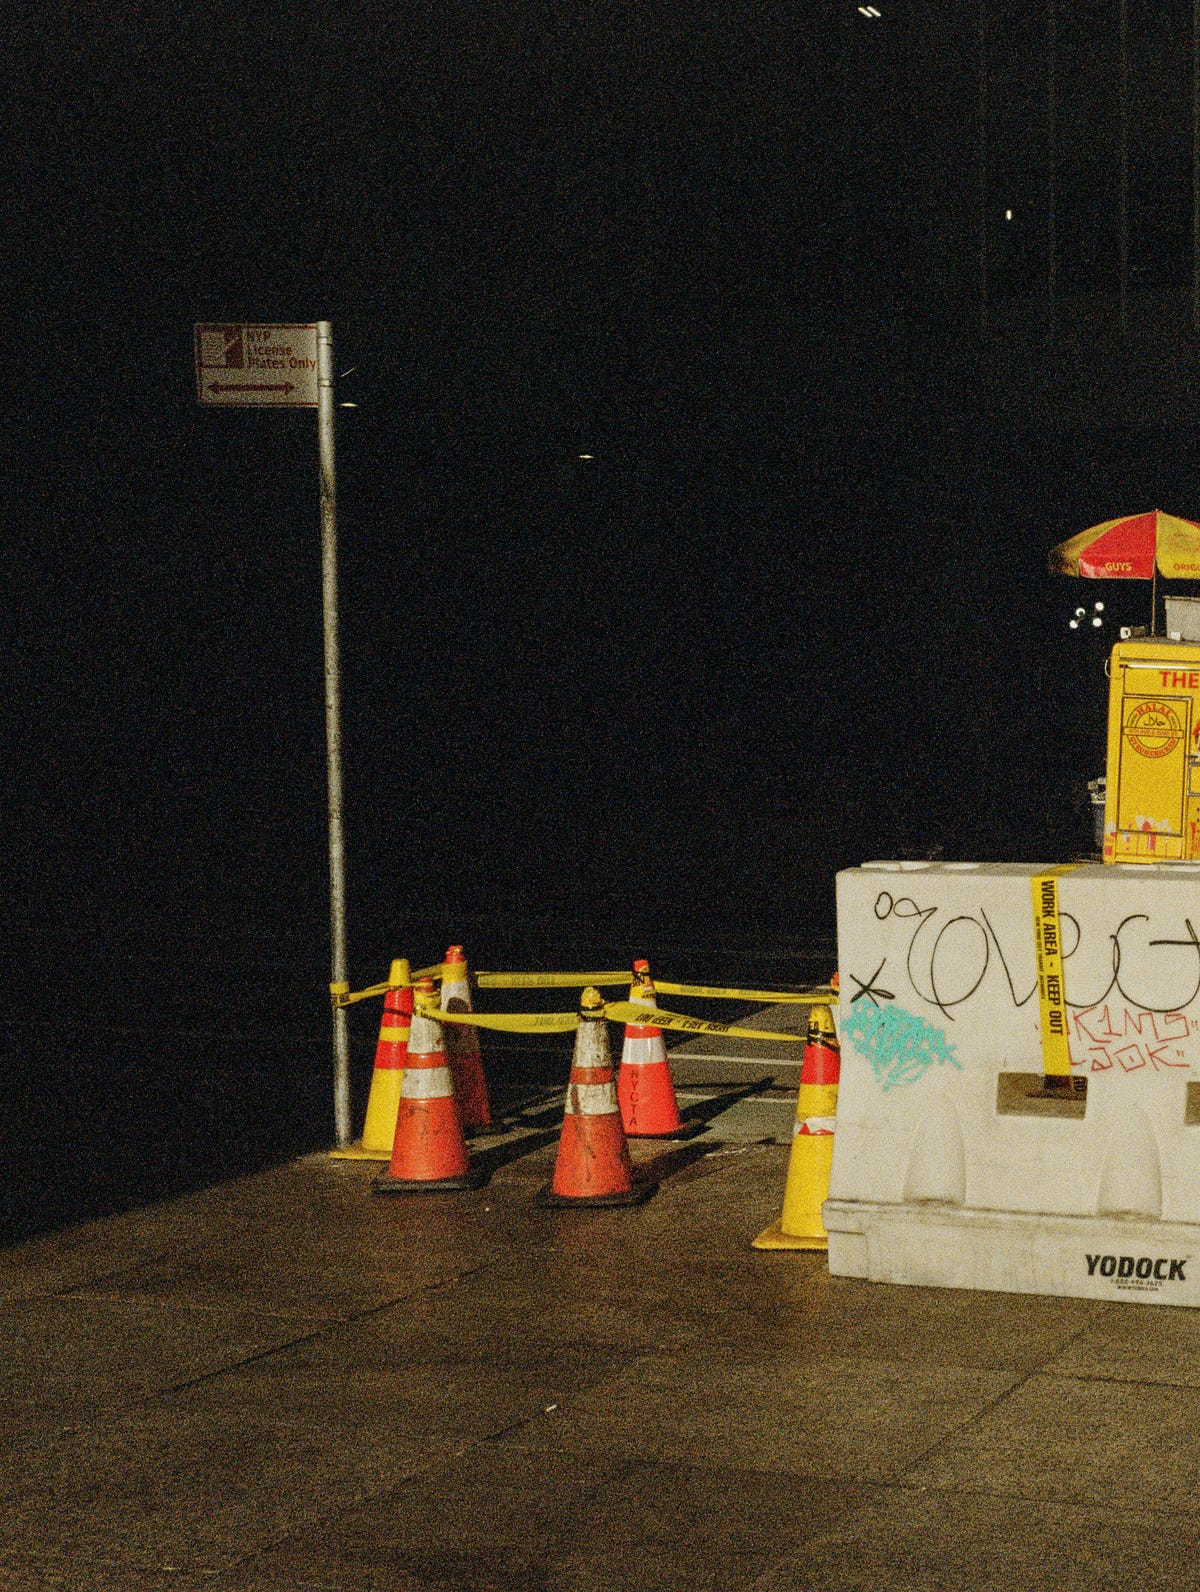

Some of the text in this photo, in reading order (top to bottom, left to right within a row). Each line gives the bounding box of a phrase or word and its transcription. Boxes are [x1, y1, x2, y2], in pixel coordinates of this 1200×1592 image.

[247, 344, 293, 356] License
[288, 356, 316, 371] Only
[1104, 561, 1132, 572] GUYS
[1159, 671, 1200, 690] THE
[1136, 702, 1172, 717] HALAL
[1041, 880, 1056, 918] WORK
[1043, 923, 1058, 956] AREA
[1046, 974, 1061, 1006] KEEP
[652, 1016, 673, 1025] KEEP
[1049, 1010, 1063, 1036] OUT
[629, 1070, 640, 1127] NYCTA
[1085, 1254, 1187, 1281] YODOCK
